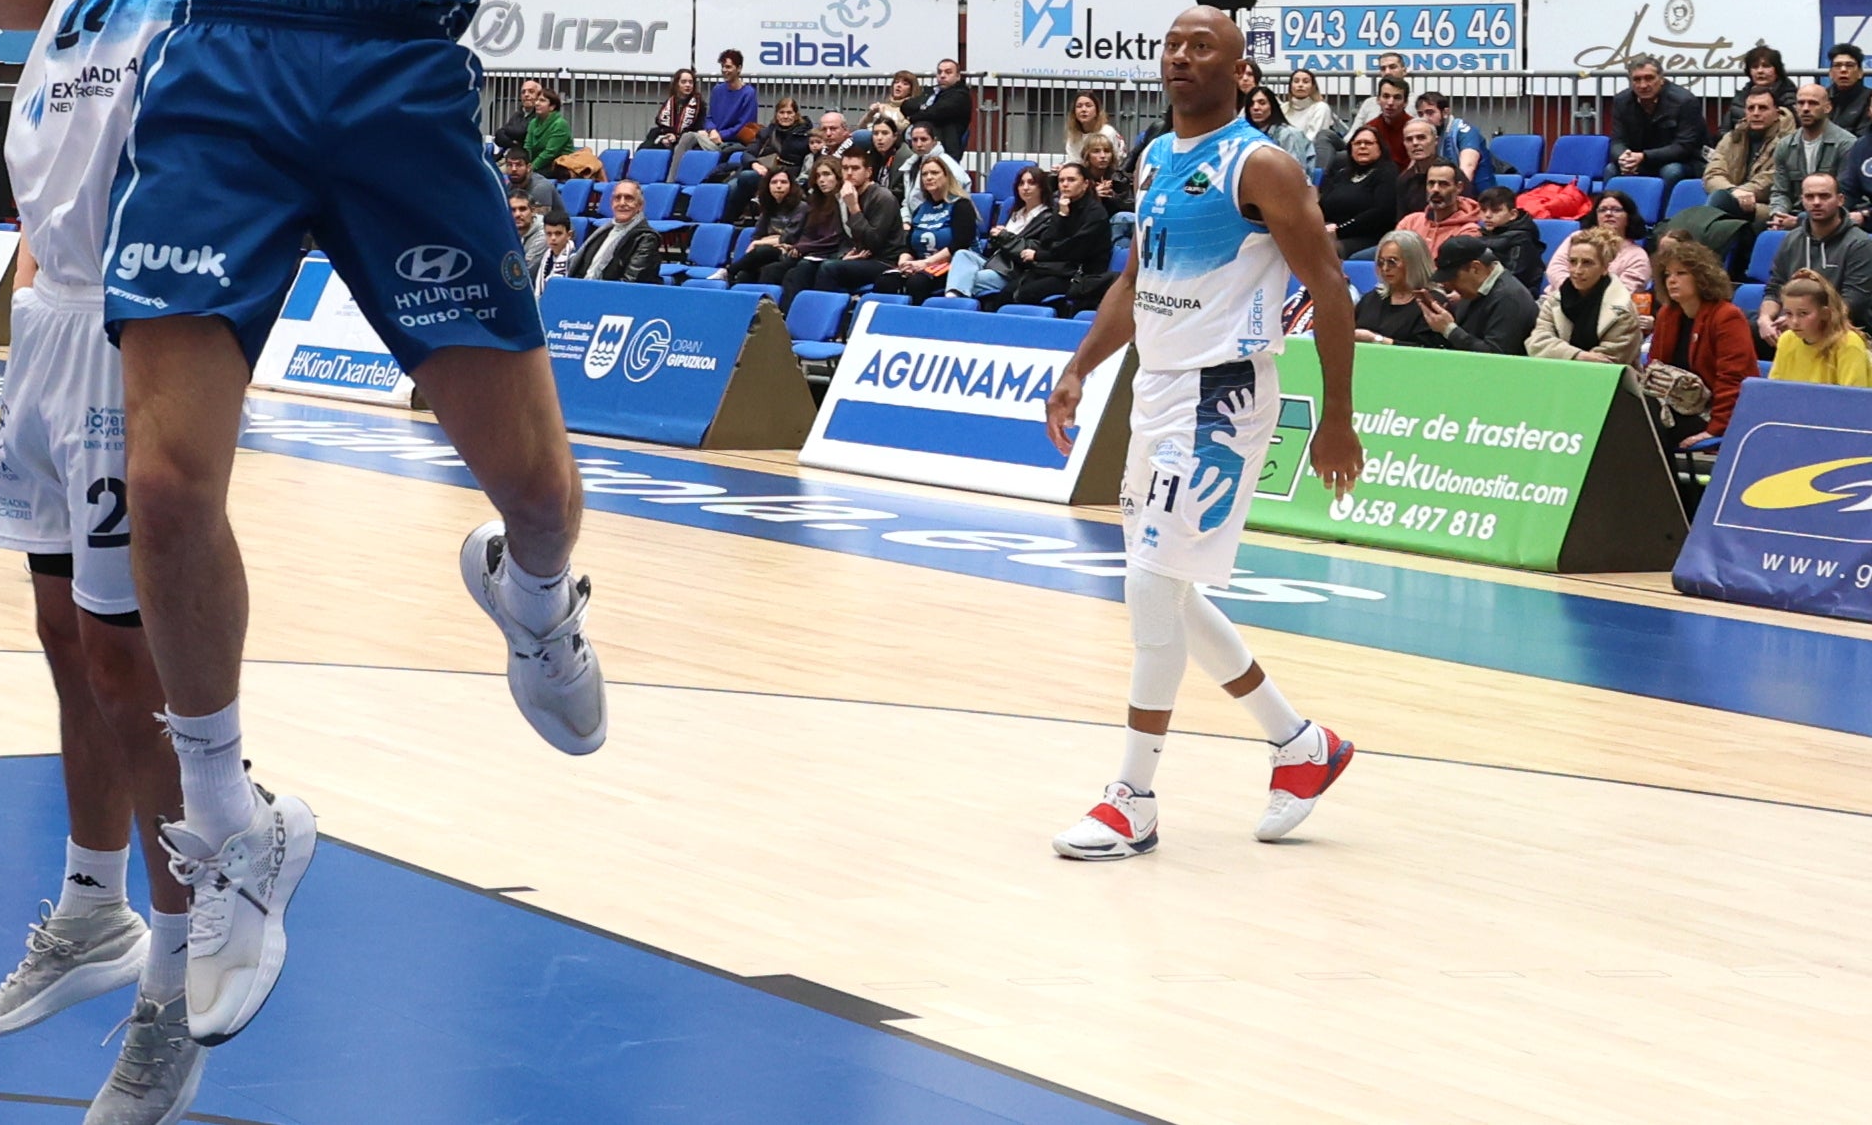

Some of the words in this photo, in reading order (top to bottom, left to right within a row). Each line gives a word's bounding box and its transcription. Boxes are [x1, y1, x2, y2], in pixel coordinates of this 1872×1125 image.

[538, 11, 669, 55] Irizar
[760, 20, 819, 30] GRUPO
[1065, 7, 1162, 60] elektr
[1284, 8, 1347, 48] 943
[1357, 8, 1402, 48] 46
[1411, 8, 1456, 47] 46
[1466, 7, 1512, 47] 46
[758, 32, 871, 69] aibak
[1285, 53, 1355, 71] TAXI
[116, 242, 231, 288] guuk.
[394, 282, 489, 311] HYUNDAI
[399, 308, 460, 328] Oarso
[666, 354, 717, 371] GIPUZKOA
[671, 339, 704, 353] ORAIN
[289, 349, 401, 389] #KirolTxartela
[855, 348, 1054, 404] AGUINAMA
[1352, 408, 1420, 438] quiler
[1423, 414, 1459, 442] de
[1464, 417, 1584, 455] trasteros
[1351, 498, 1397, 526] 658
[1399, 504, 1447, 532] 497
[1448, 509, 1497, 540] 818
